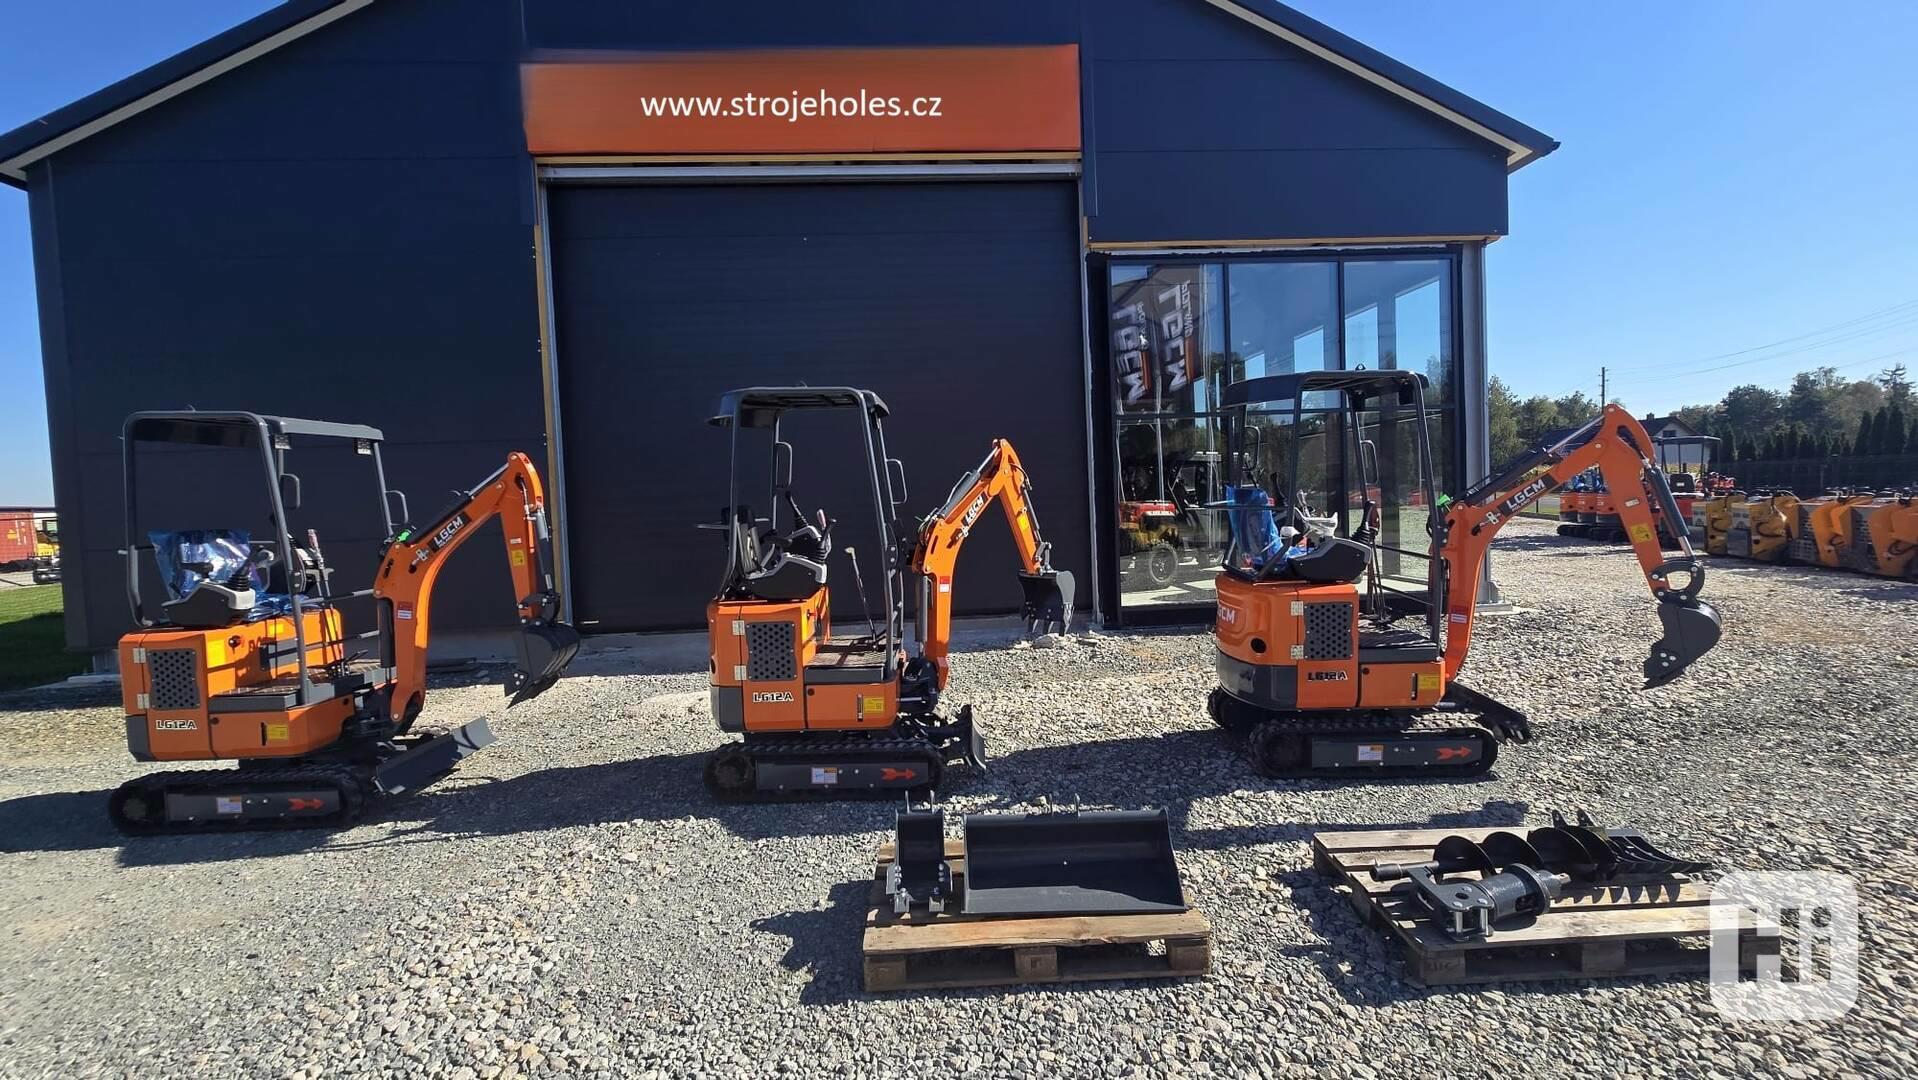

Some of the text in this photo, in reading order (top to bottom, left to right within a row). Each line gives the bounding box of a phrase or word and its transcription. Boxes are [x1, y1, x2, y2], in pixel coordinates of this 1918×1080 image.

[1506, 478, 1546, 509] LGCM
[434, 516, 463, 545] LGCM
[752, 691, 794, 703] LG12A
[156, 719, 197, 730] LG12A
